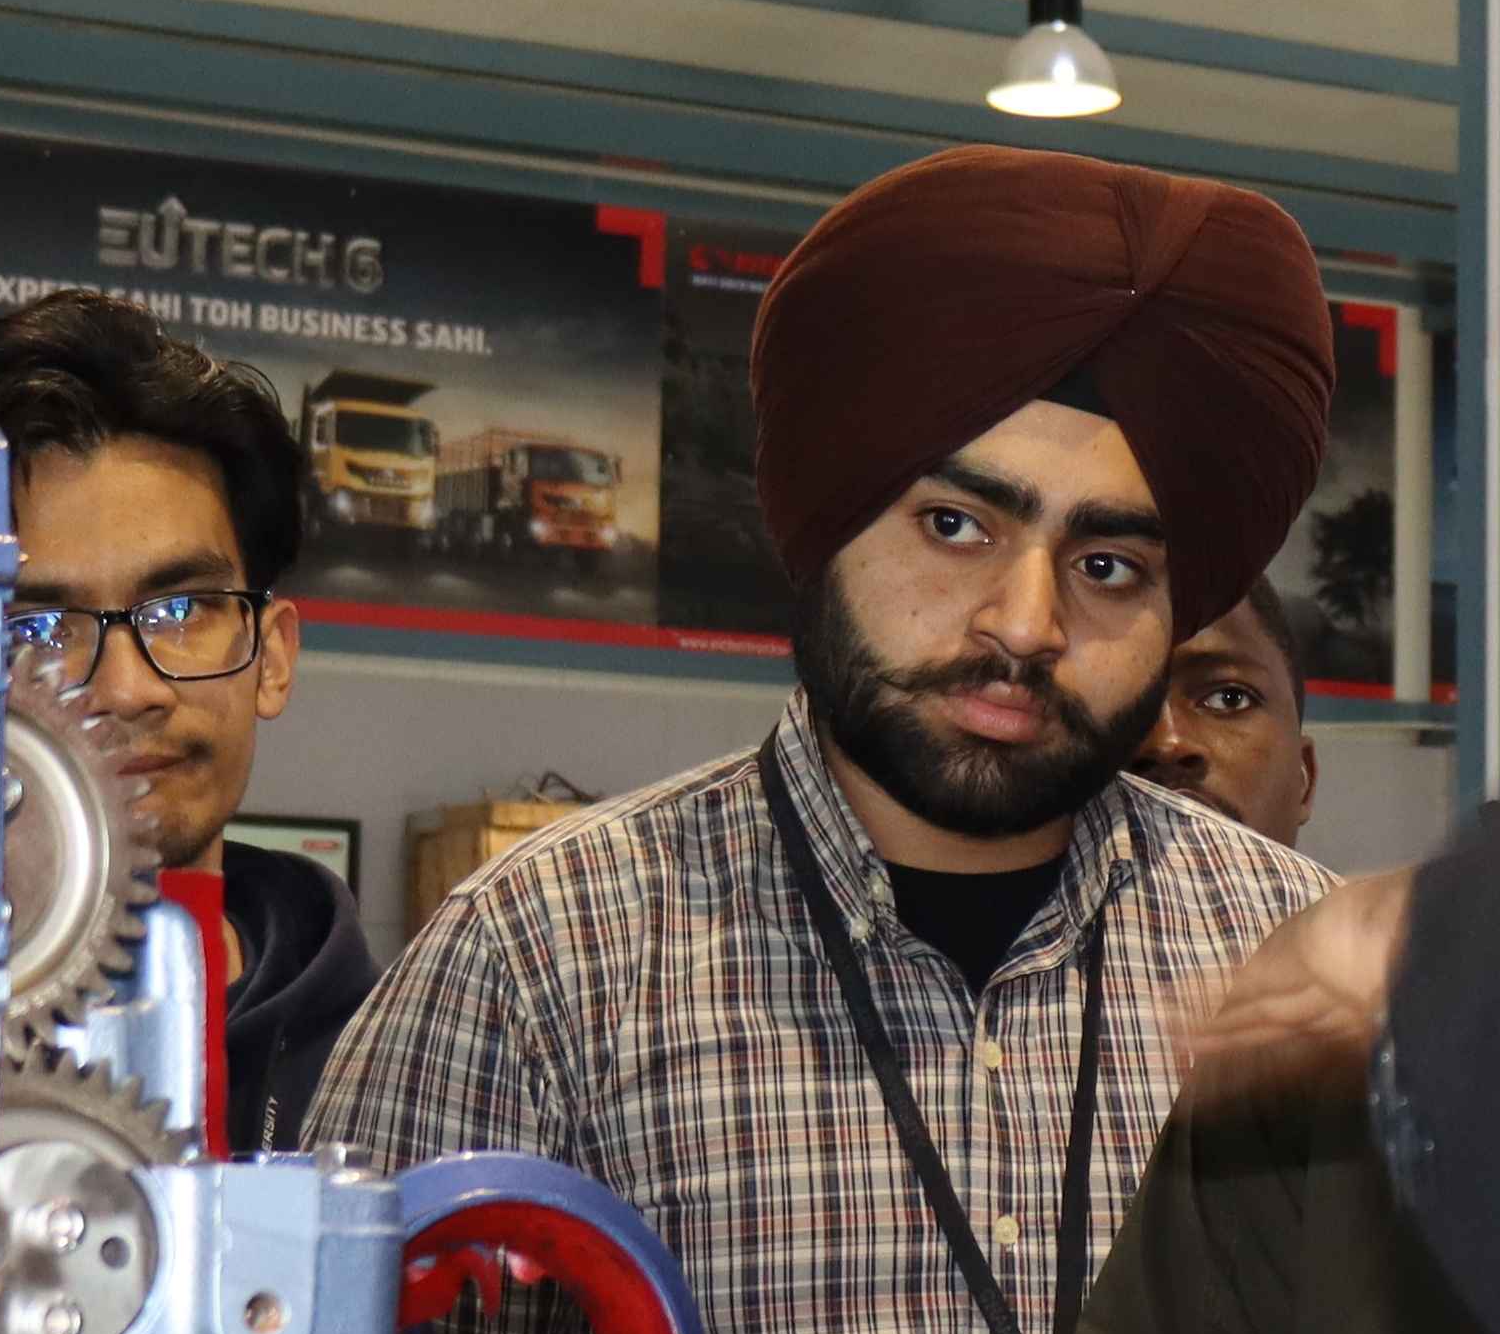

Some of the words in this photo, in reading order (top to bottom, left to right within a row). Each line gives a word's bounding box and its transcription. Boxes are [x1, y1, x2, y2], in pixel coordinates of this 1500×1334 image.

[98, 194, 336, 288] EUTECH
[191, 297, 252, 330] TOH
[259, 303, 408, 347] BUSINESS
[414, 322, 493, 355] SAHI.
